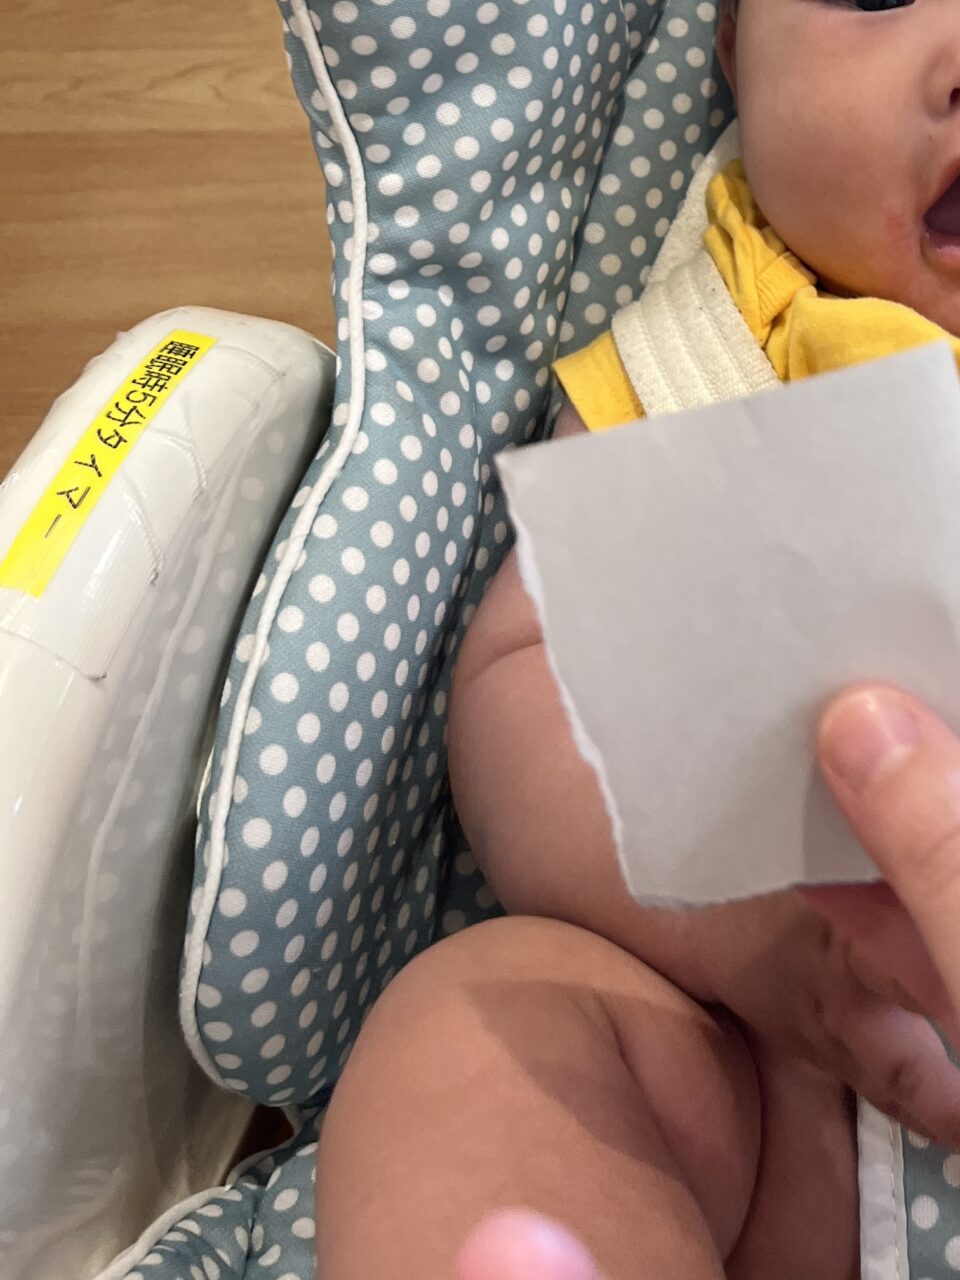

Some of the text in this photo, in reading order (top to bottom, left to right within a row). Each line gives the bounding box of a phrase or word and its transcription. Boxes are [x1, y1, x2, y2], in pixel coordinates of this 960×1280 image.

[44, 340, 200, 539] 睡眠時5分タイマー
